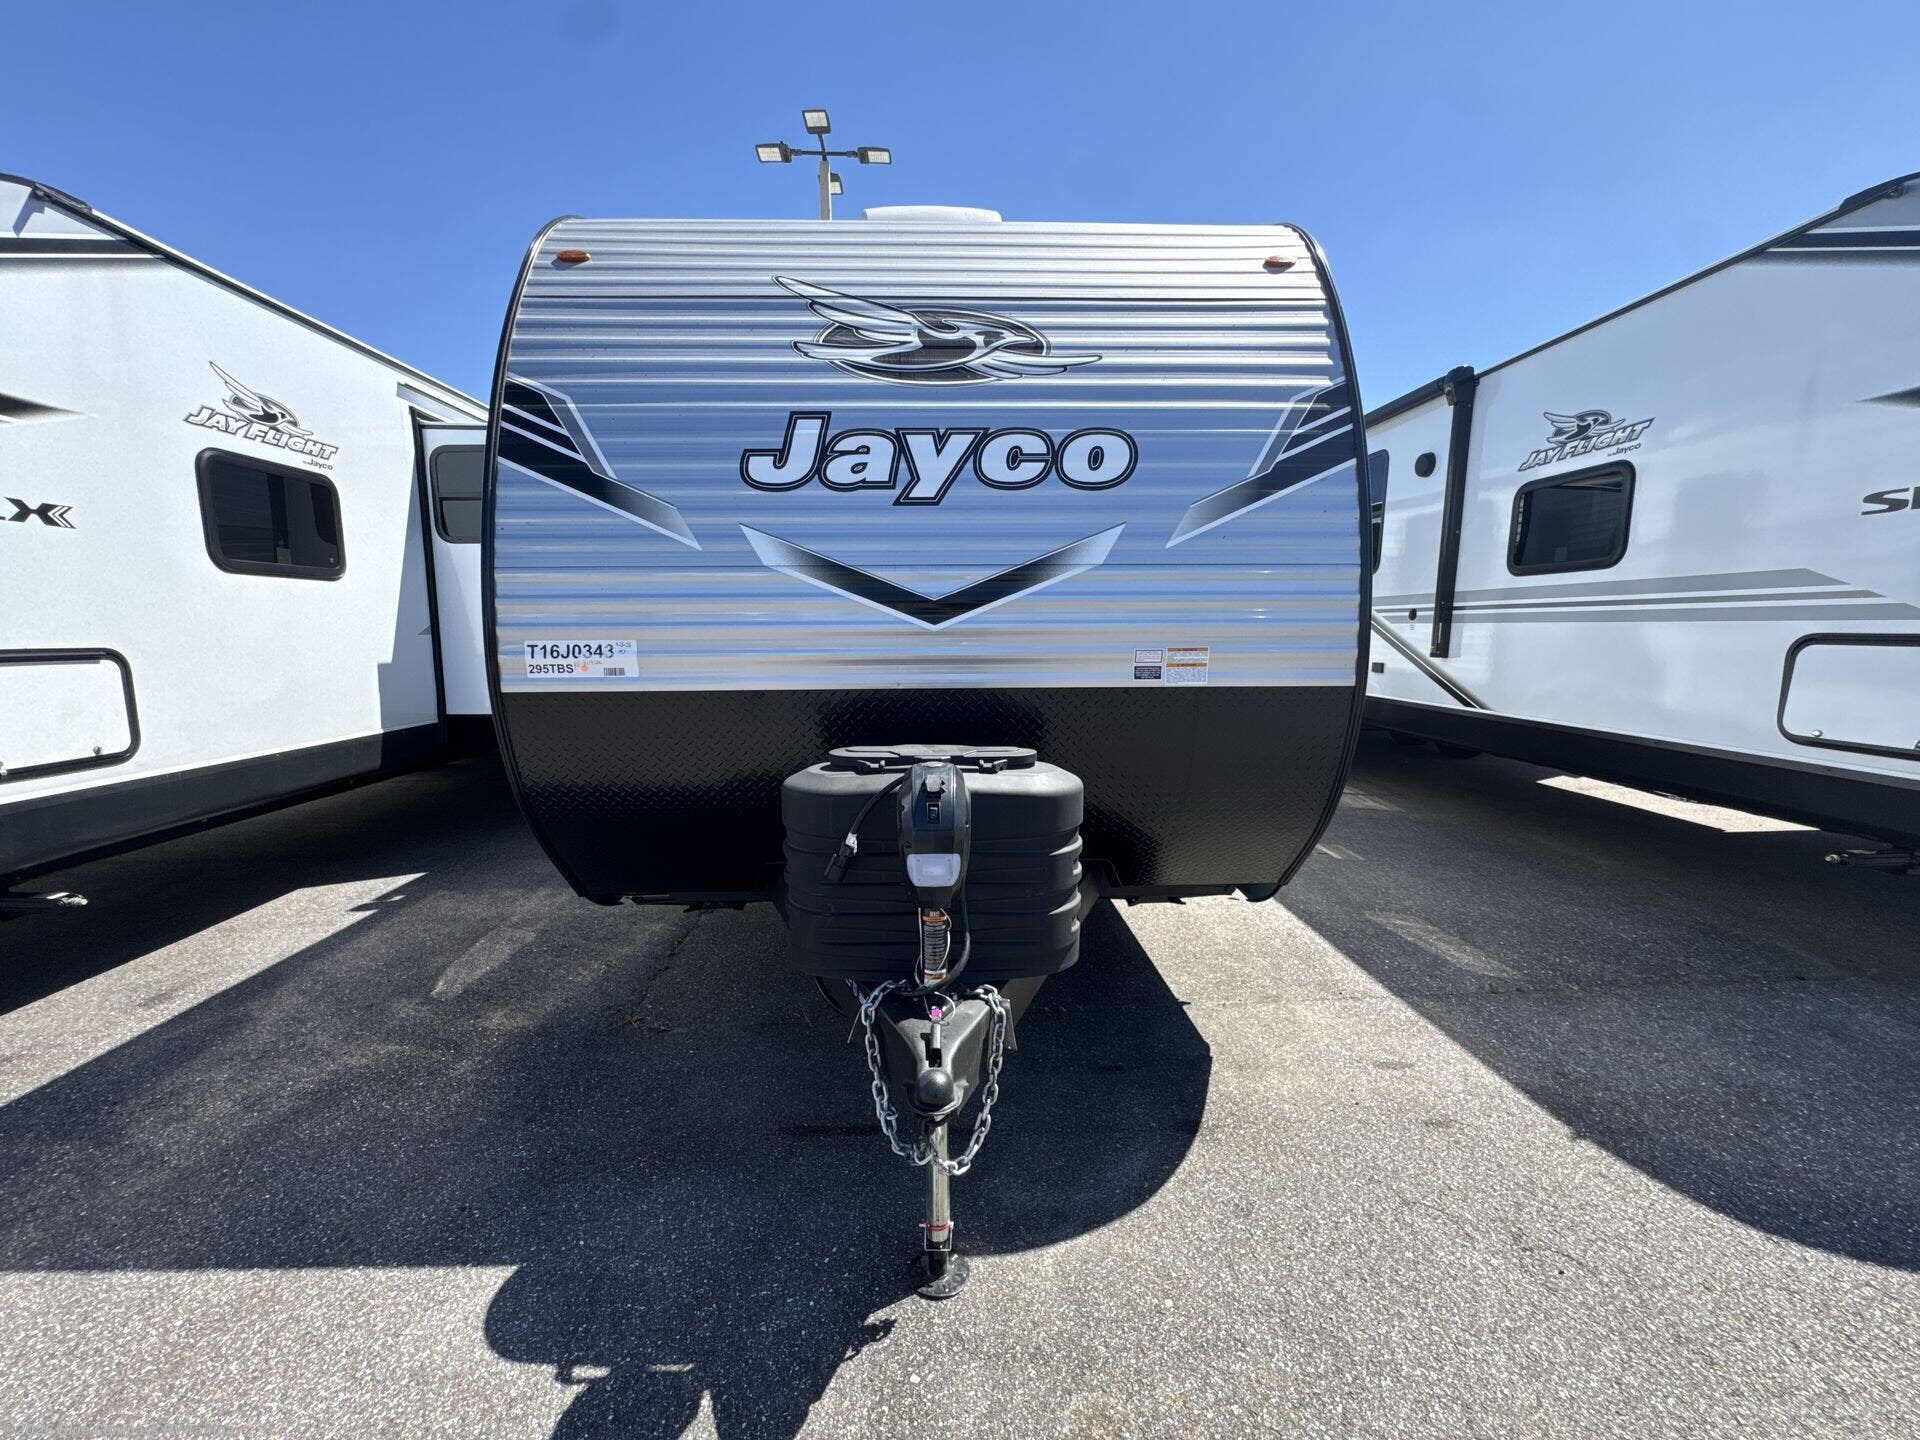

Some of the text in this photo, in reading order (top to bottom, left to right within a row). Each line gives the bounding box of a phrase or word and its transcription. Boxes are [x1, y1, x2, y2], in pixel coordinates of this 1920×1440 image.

[183, 404, 339, 460] JAY FLIGHT
[1517, 417, 1656, 472] JAY FLIGHT
[1615, 442, 1641, 455] Jayco
[307, 458, 333, 470] Jayco
[739, 411, 1139, 506] Jayco
[0, 496, 76, 529] X
[527, 643, 614, 659] T16J0343
[528, 663, 574, 674] 295TBS
